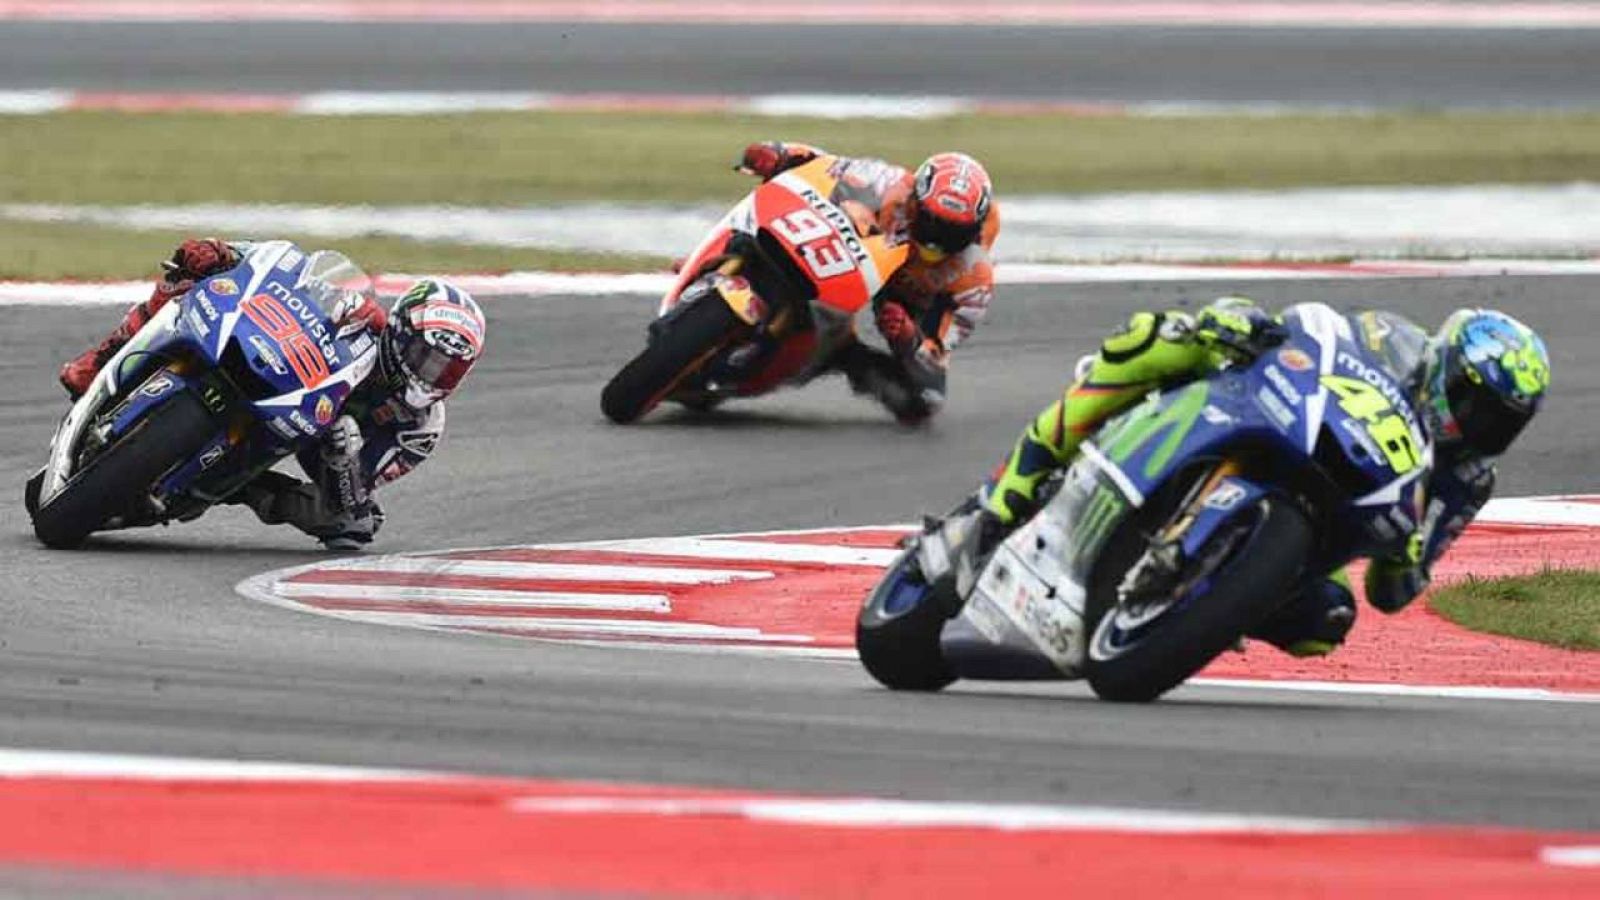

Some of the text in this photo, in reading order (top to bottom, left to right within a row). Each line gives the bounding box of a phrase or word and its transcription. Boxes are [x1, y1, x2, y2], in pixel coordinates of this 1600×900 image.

[771, 208, 856, 280] 93
[239, 293, 331, 390] 99
[267, 280, 341, 366] movistar
[1319, 374, 1422, 475] 46
